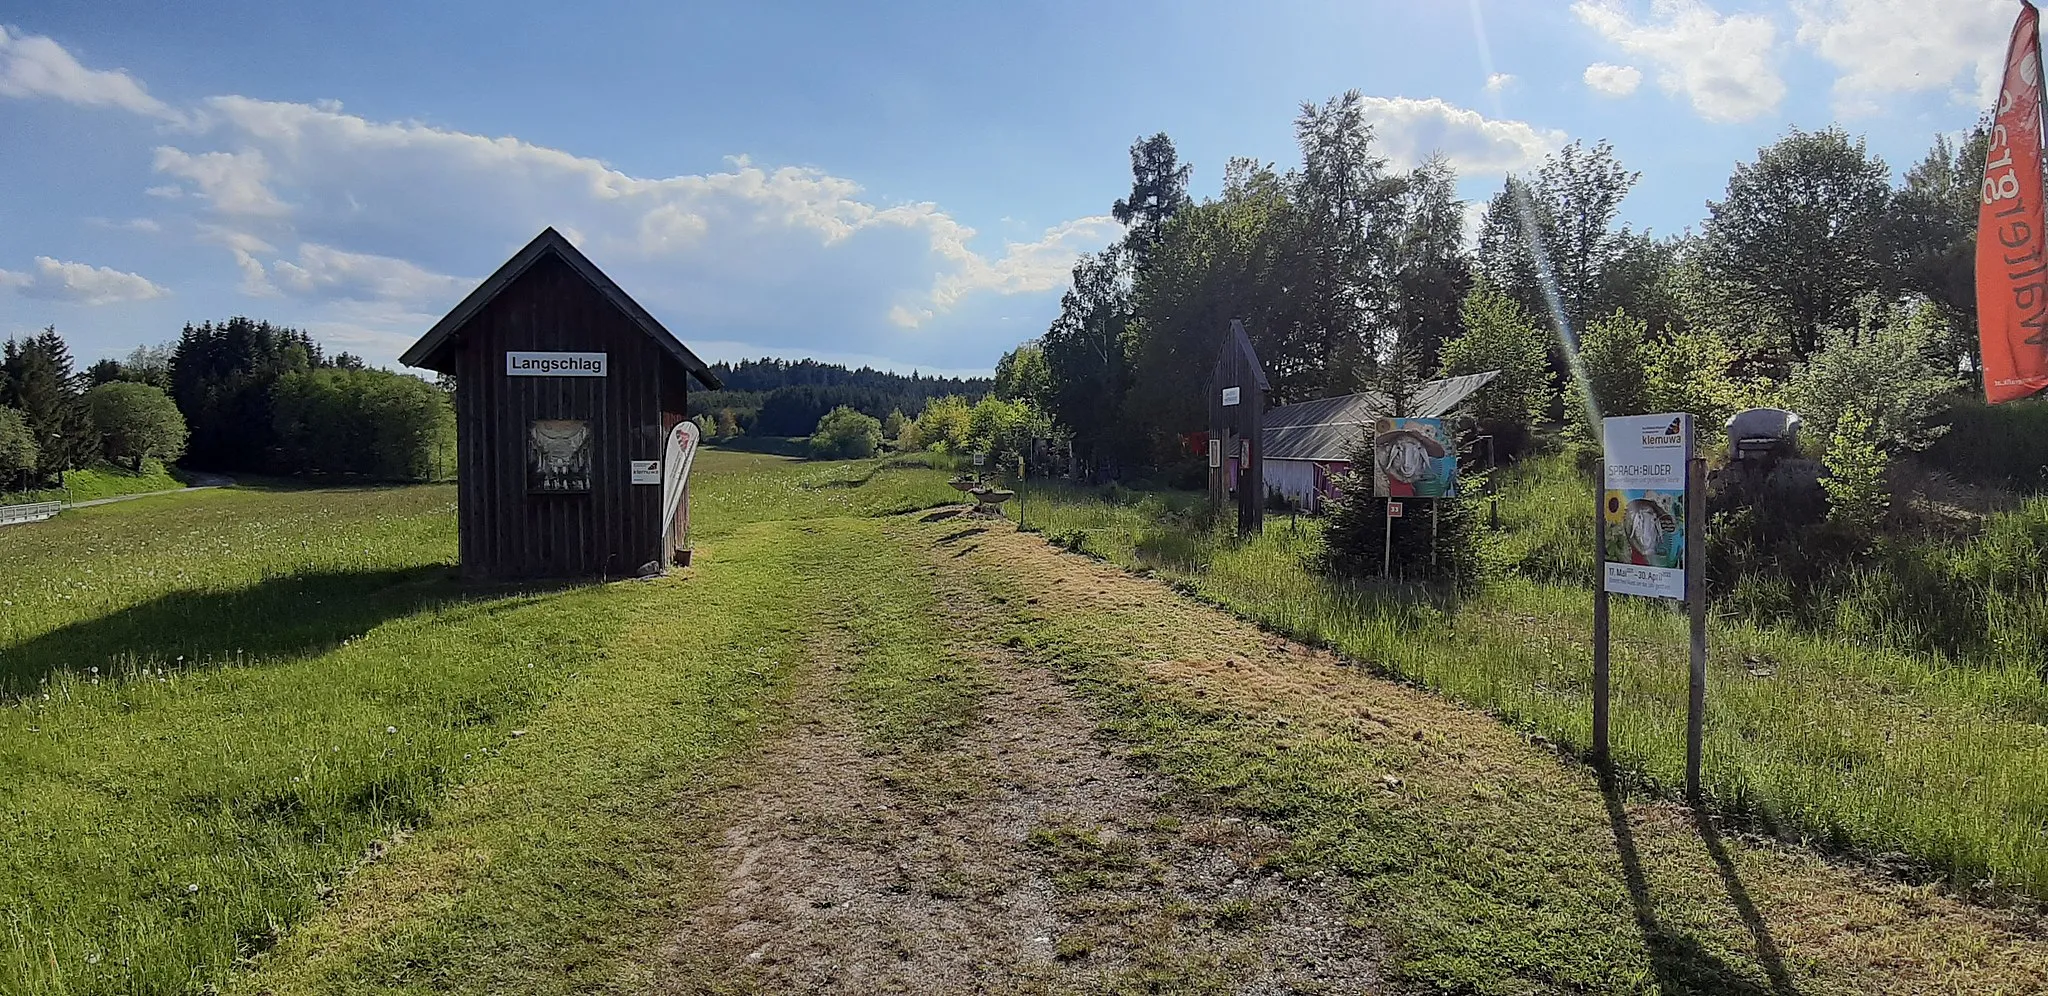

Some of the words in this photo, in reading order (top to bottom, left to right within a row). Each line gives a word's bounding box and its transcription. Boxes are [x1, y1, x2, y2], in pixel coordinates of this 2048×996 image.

[512, 356, 602, 373] Langschlag
[1642, 435, 1682, 445] klemuwa
[1608, 464, 1672, 476] SPRACH:BILDER
